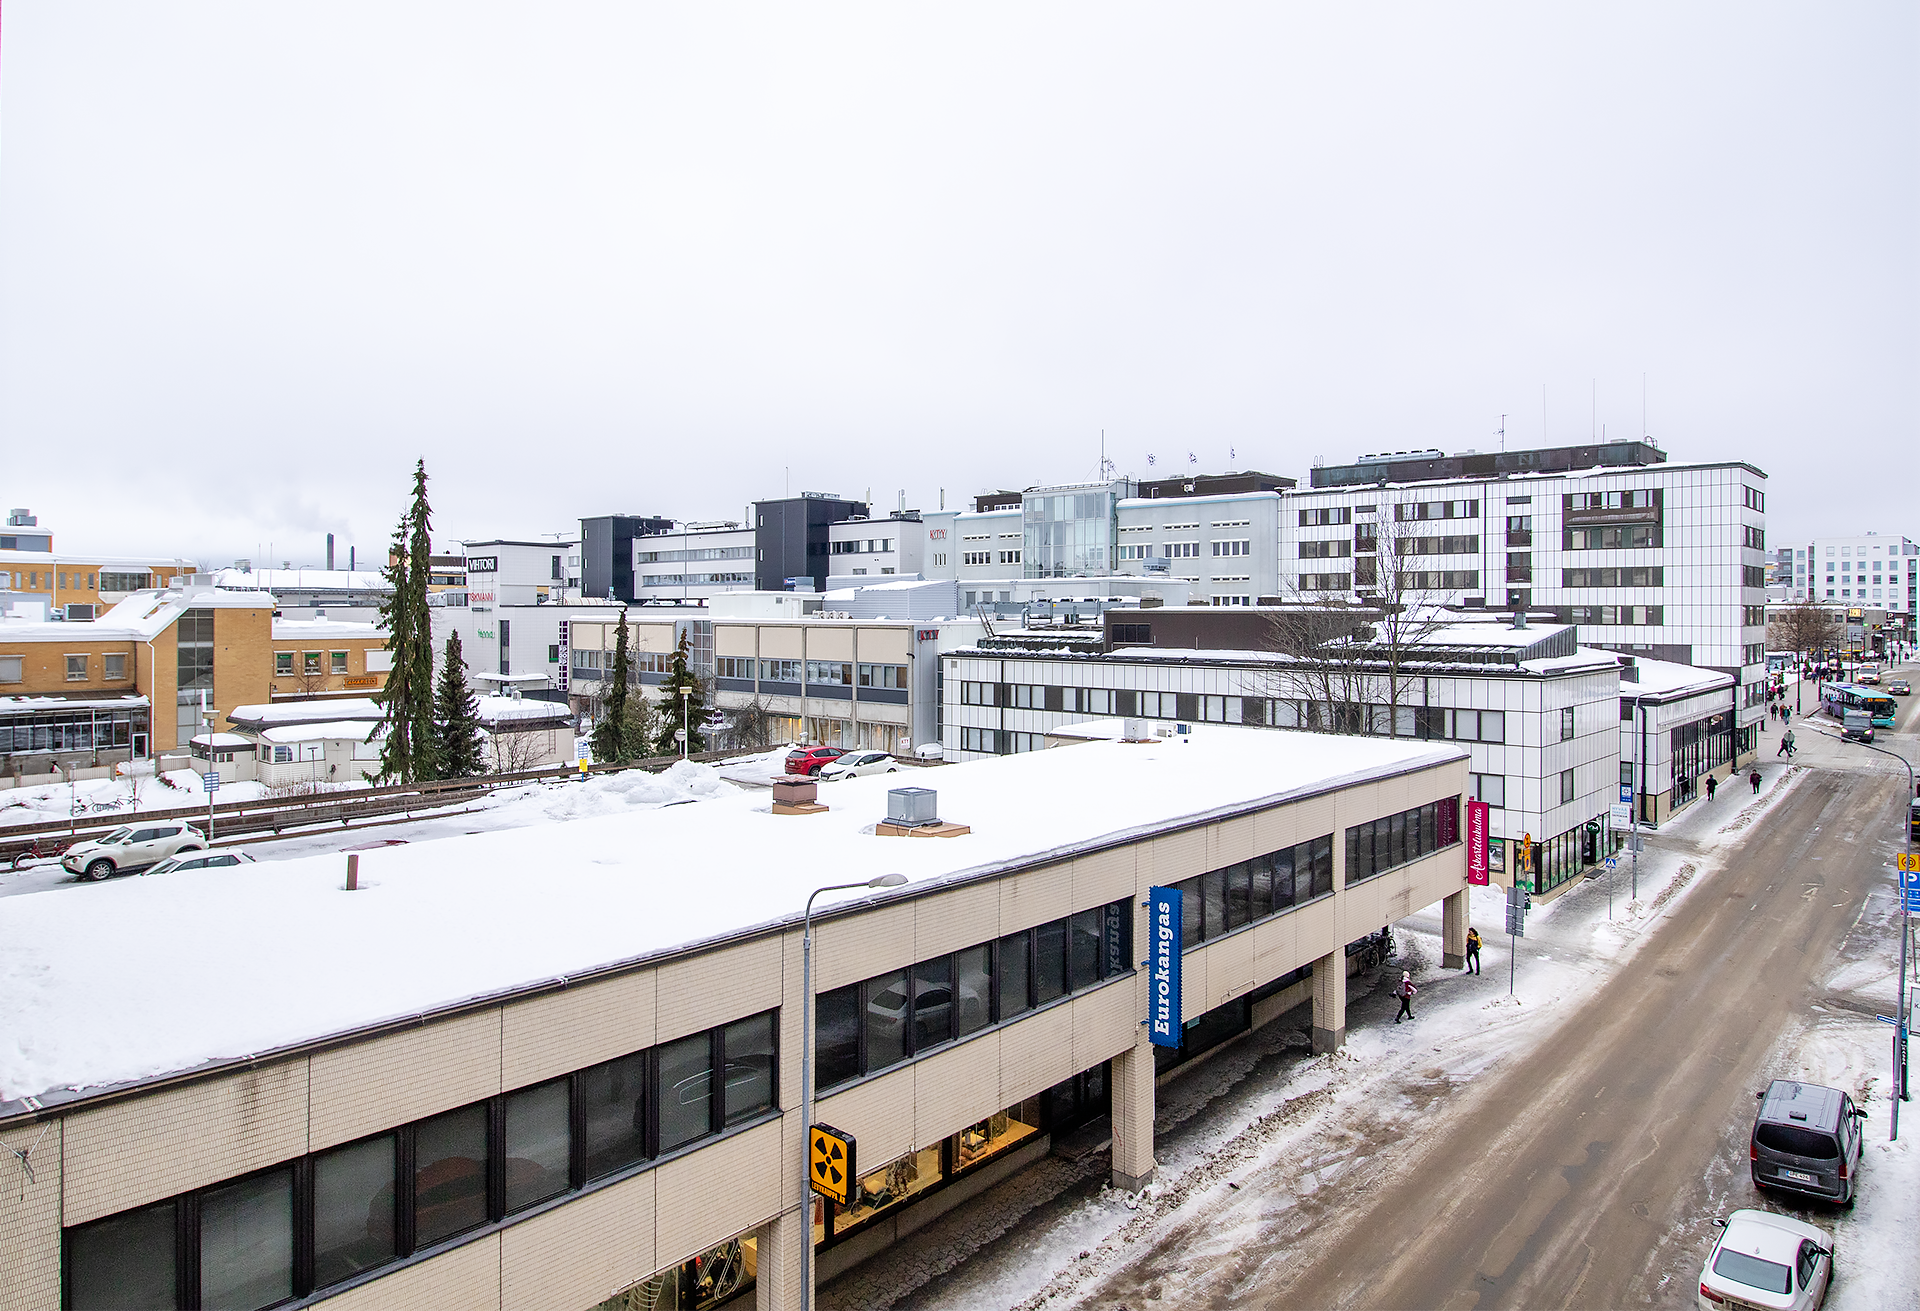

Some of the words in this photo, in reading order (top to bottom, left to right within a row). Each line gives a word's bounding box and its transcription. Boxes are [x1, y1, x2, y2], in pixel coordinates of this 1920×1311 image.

[469, 558, 495, 571] VIHTORI
[919, 629, 939, 640] KTY
[1470, 806, 1486, 880] Askartelukulma
[1155, 902, 1174, 1036] Eurokangas
